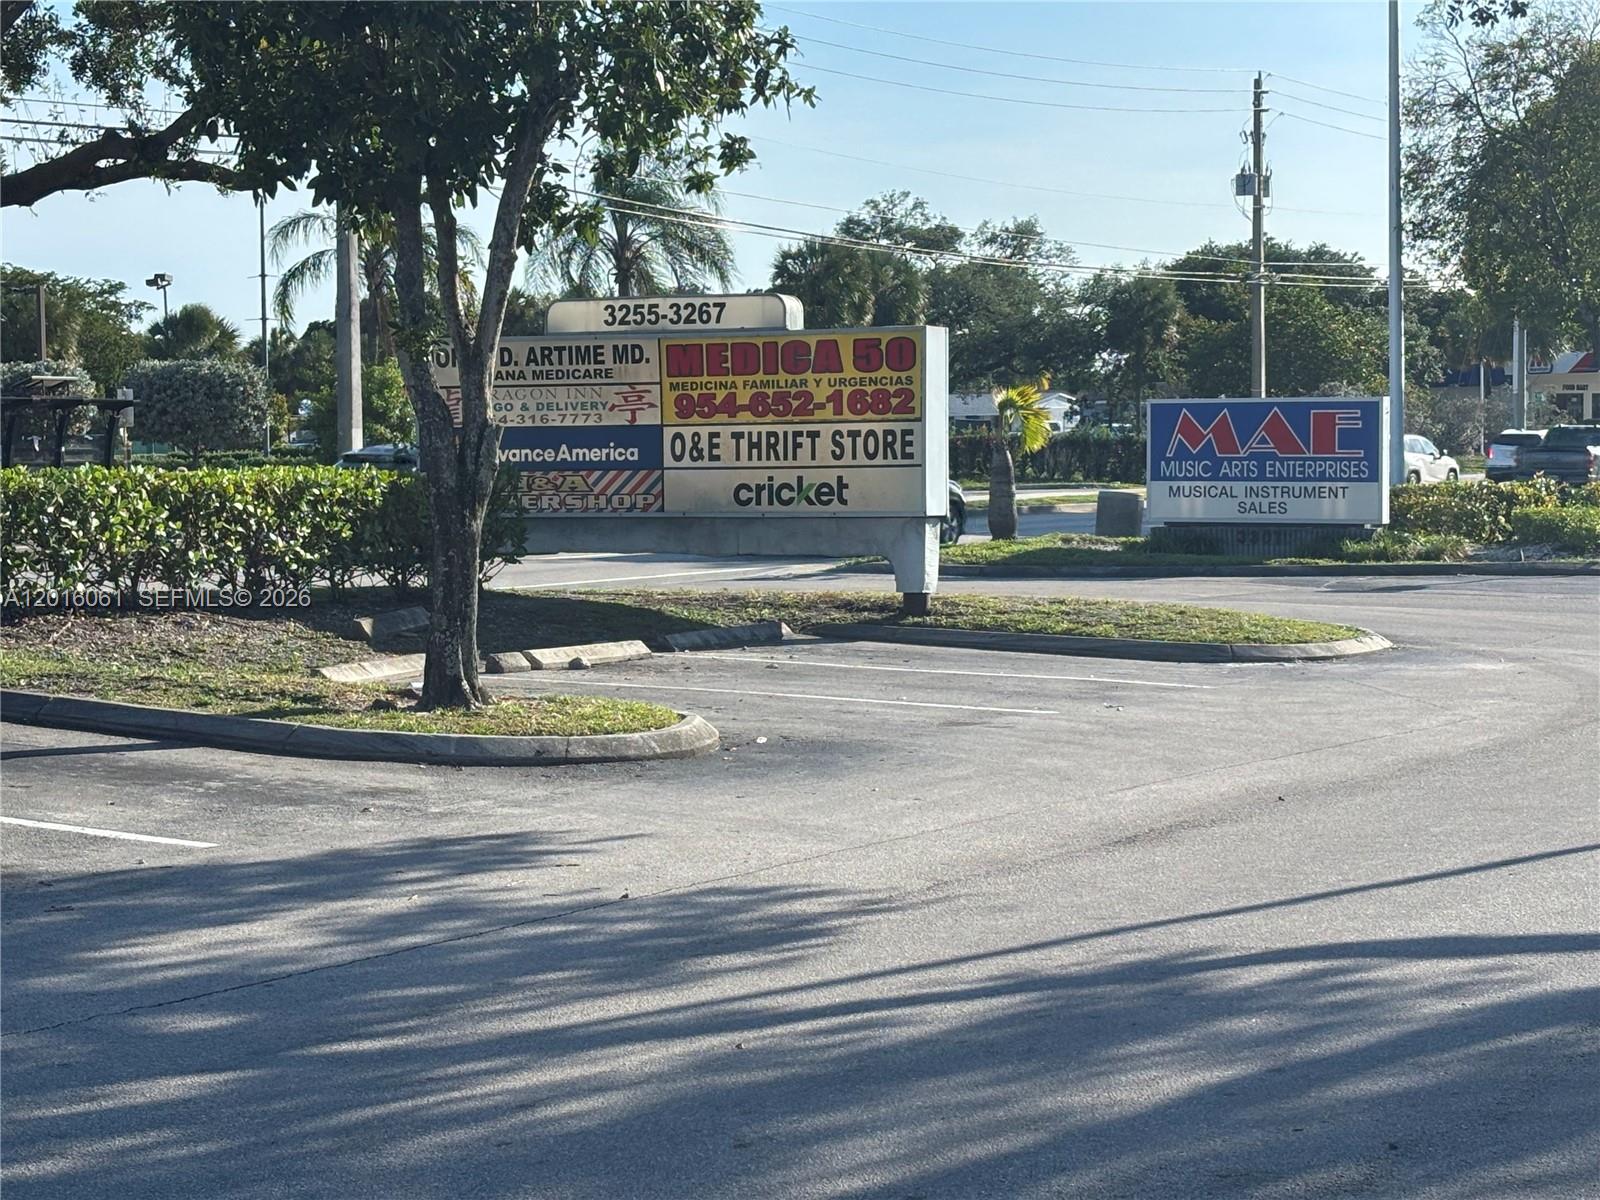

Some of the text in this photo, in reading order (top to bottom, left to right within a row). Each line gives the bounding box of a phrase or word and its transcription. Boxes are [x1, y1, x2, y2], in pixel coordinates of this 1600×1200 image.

[603, 302, 727, 327] 3255-3267
[499, 344, 650, 368] D. ARTIME MD.
[666, 336, 917, 377] MEDICA 50
[494, 368, 614, 381] ANA MEDICARE
[669, 376, 914, 392] MEDICINA FAMILIAR Y URGENCIAS
[491, 387, 603, 400] RAGON INN
[494, 401, 609, 412] GO & DELIVERY
[608, 385, 658, 425] 亭
[673, 388, 916, 419] 954-652-1682
[493, 413, 603, 425] 4-316-7773
[498, 442, 639, 462] vanceAmerica
[670, 428, 915, 462] O&E THRIFT STORE
[1160, 460, 1369, 478] MUSIC ARTS ENTERPRISES
[733, 475, 849, 507] cricket
[1168, 485, 1349, 499] MUSICAL INSTRUMENT
[1237, 502, 1288, 515] SALES
